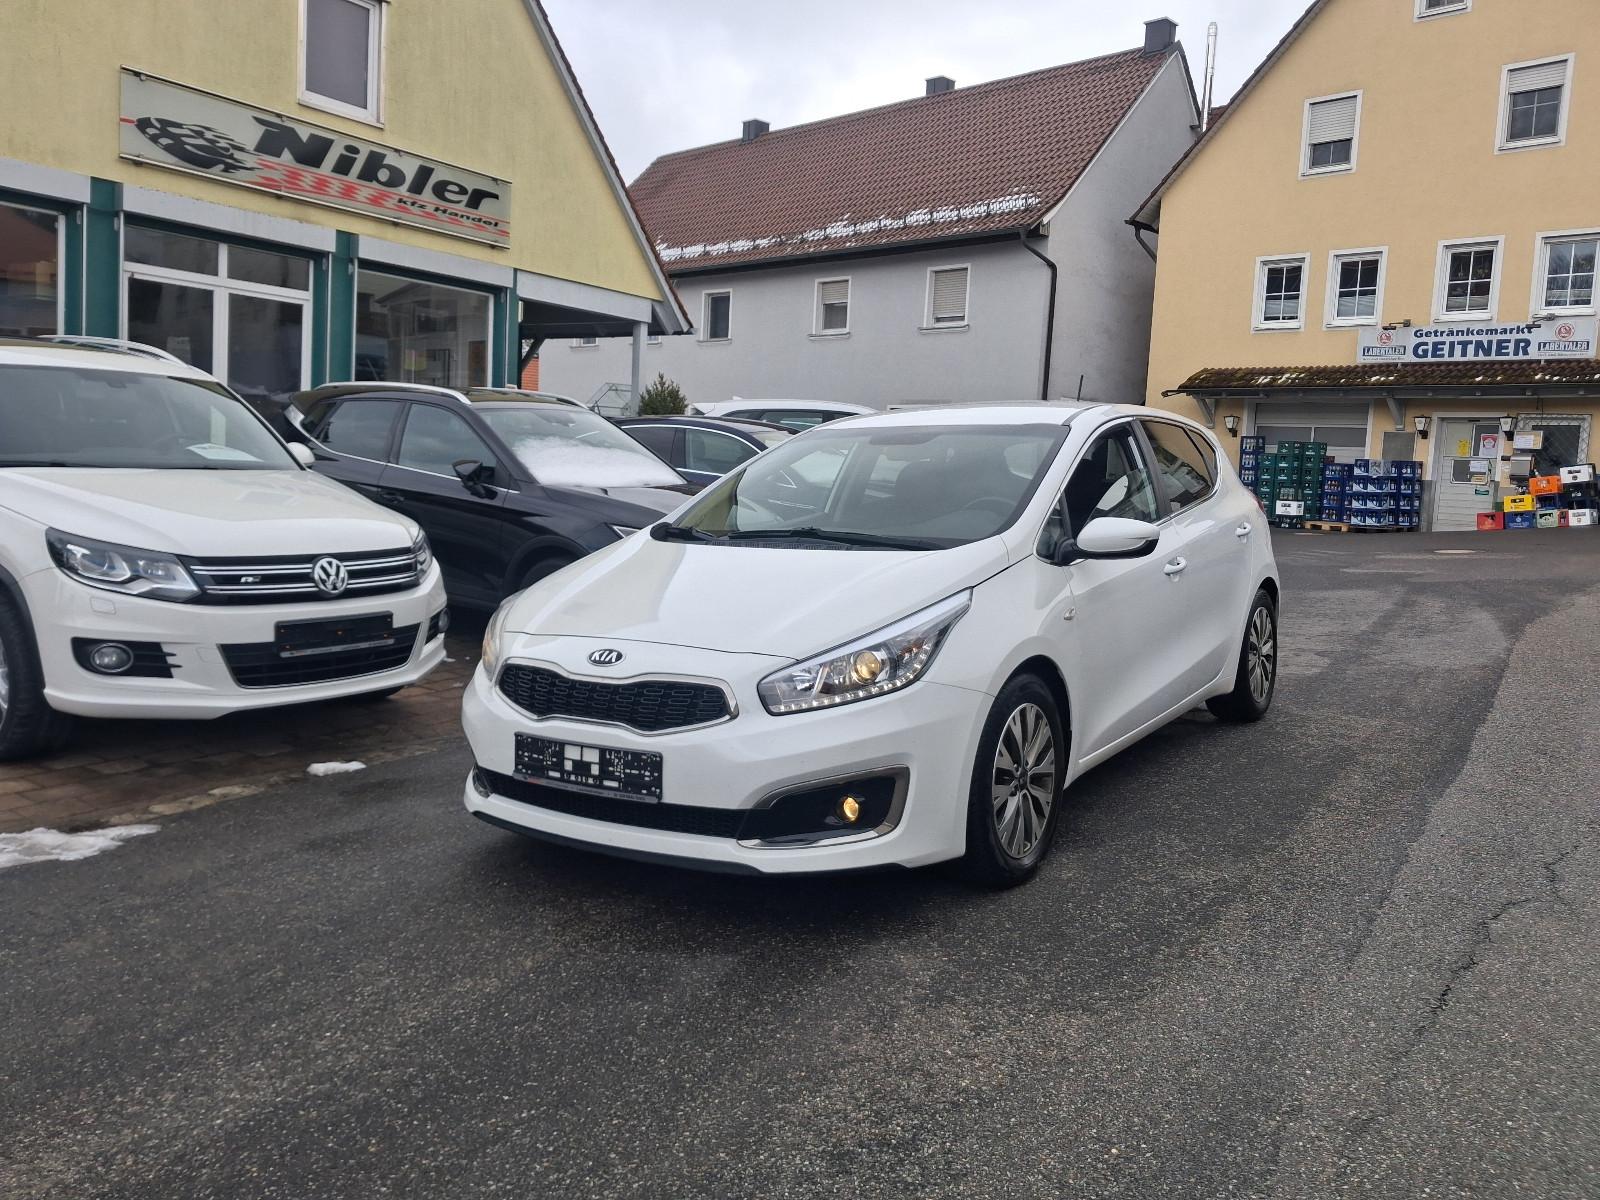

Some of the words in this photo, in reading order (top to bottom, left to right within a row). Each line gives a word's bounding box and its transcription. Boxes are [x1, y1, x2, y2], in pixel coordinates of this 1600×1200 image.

[252, 115, 499, 210] Nibler
[433, 206, 499, 227] Handel
[1413, 325, 1534, 338] Getränkemarkt
[1363, 345, 1406, 356] LABERTALER
[1412, 338, 1531, 358] GEITNER
[1538, 341, 1589, 351] LABERTALER
[590, 650, 618, 662] KIA
